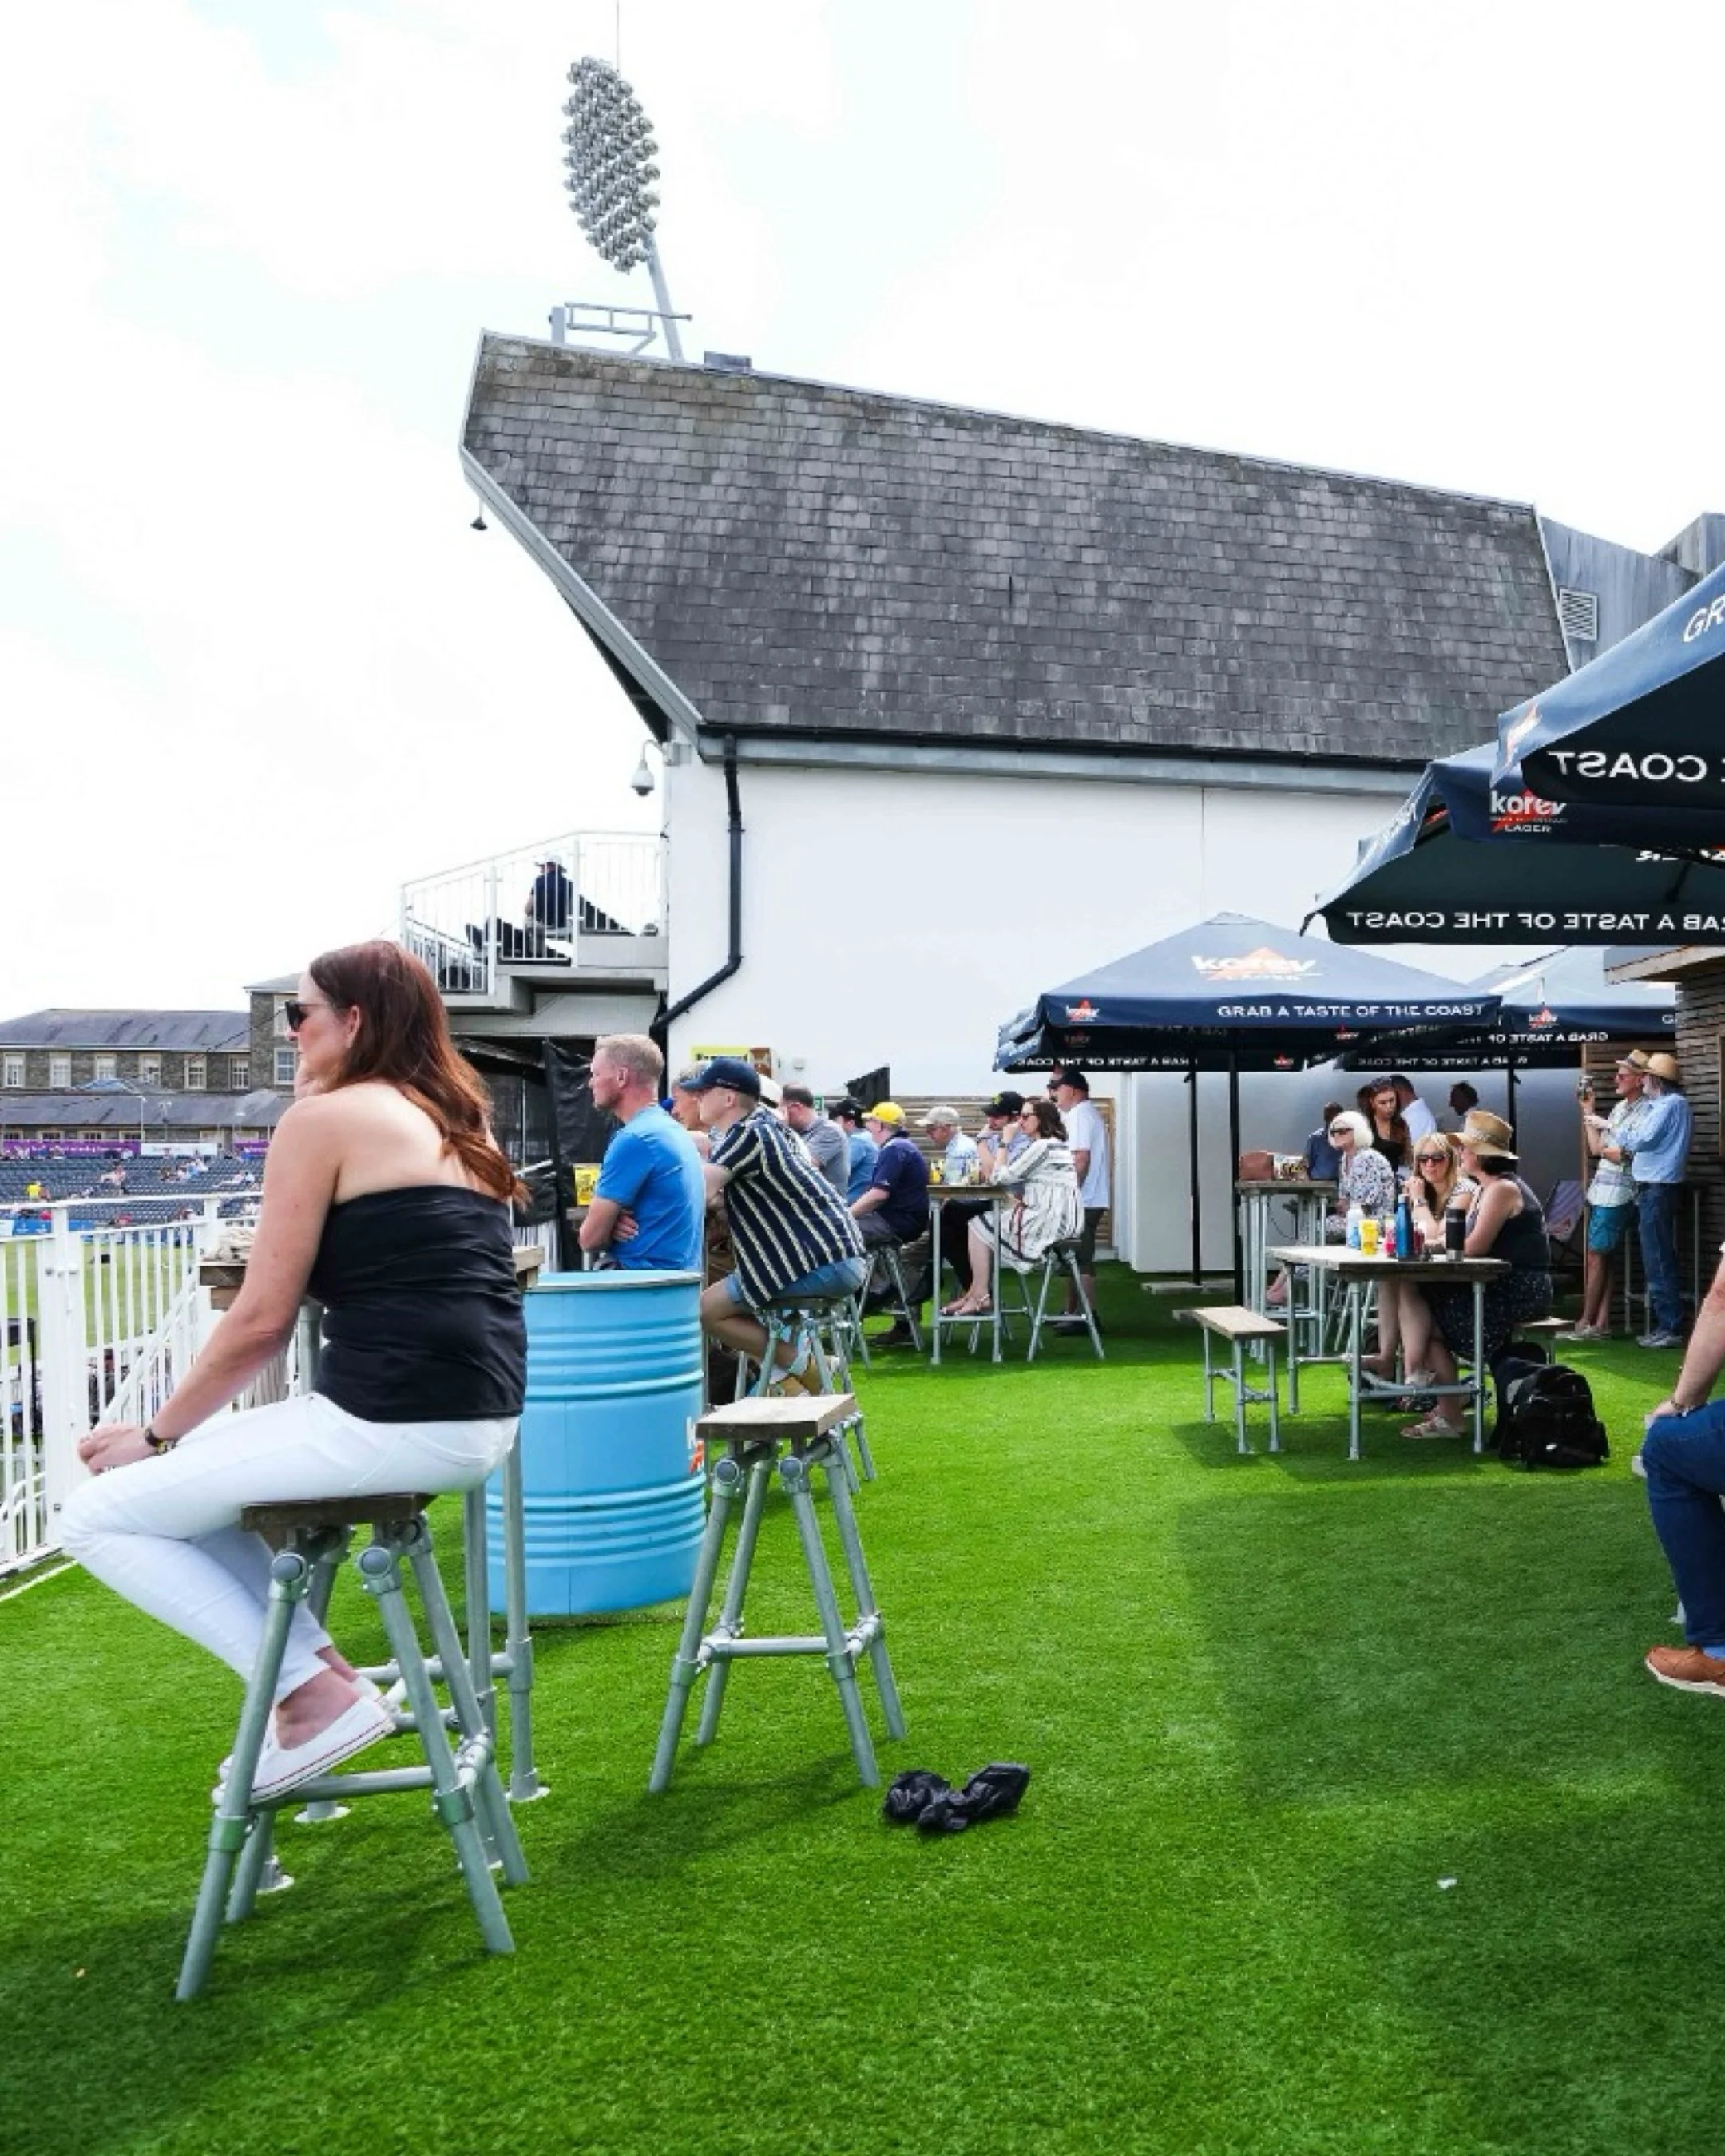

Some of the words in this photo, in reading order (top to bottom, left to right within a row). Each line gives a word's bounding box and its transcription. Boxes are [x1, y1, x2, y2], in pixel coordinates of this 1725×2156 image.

[1217, 1005, 1272, 1017] GRAB
[1277, 1005, 1290, 1017] A
[1293, 1005, 1350, 1017] TASTE
[1356, 1005, 1380, 1017] OF
[1384, 1005, 1421, 1017] THE
[1424, 1004, 1485, 1017] COAST
